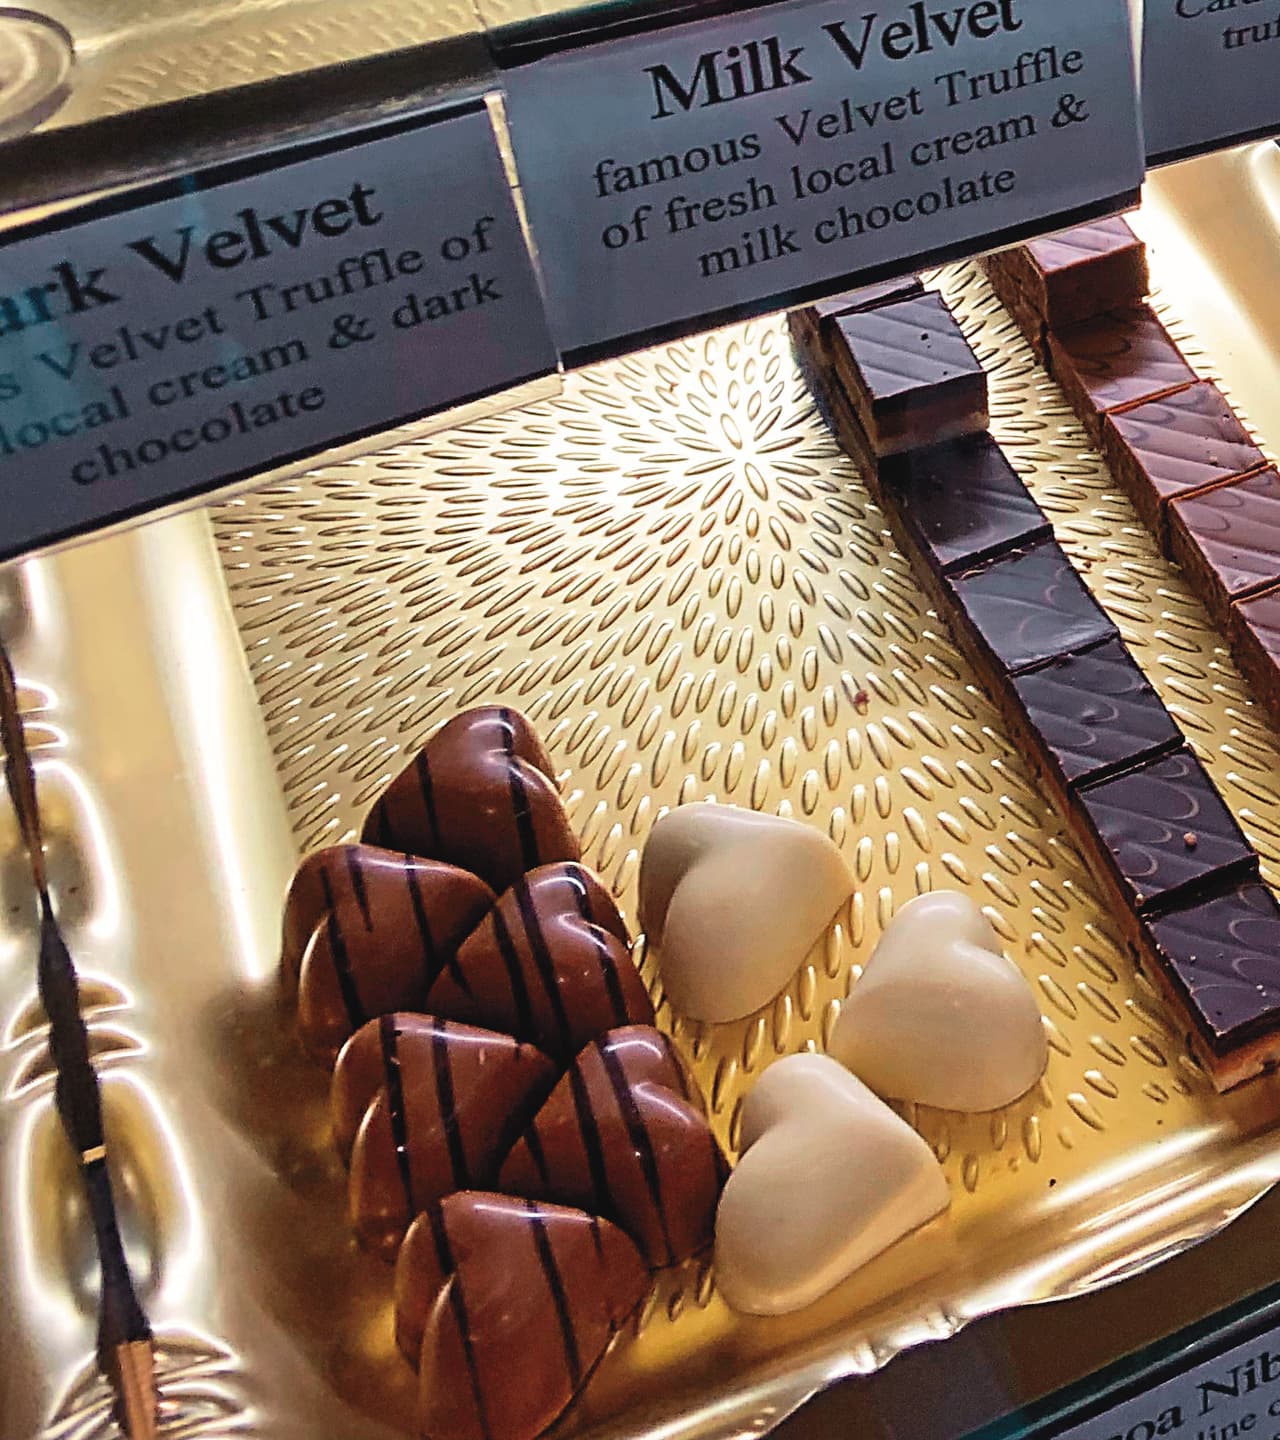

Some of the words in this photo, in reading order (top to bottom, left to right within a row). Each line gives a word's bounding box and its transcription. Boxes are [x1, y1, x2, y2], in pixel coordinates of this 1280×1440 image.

[593, 130, 762, 198] famous
[774, 84, 925, 147] Velvet
[934, 45, 1086, 107] Truffle
[643, 36, 813, 122] Milk
[126, 181, 385, 284] Velvet
[600, 206, 655, 249] of
[664, 175, 778, 236] fresh
[790, 141, 897, 201] local
[908, 116, 1039, 167] cream
[1049, 93, 1091, 128] &
[697, 224, 800, 279] milk
[814, 167, 1018, 245] chocolate
[0, 385, 133, 456] local
[147, 337, 311, 407] cream
[326, 311, 377, 350] &
[390, 273, 505, 331] dark
[38, 305, 226, 381] Velvet
[235, 247, 425, 325] Truffle
[439, 216, 498, 261] of
[70, 383, 327, 487] chocolate
